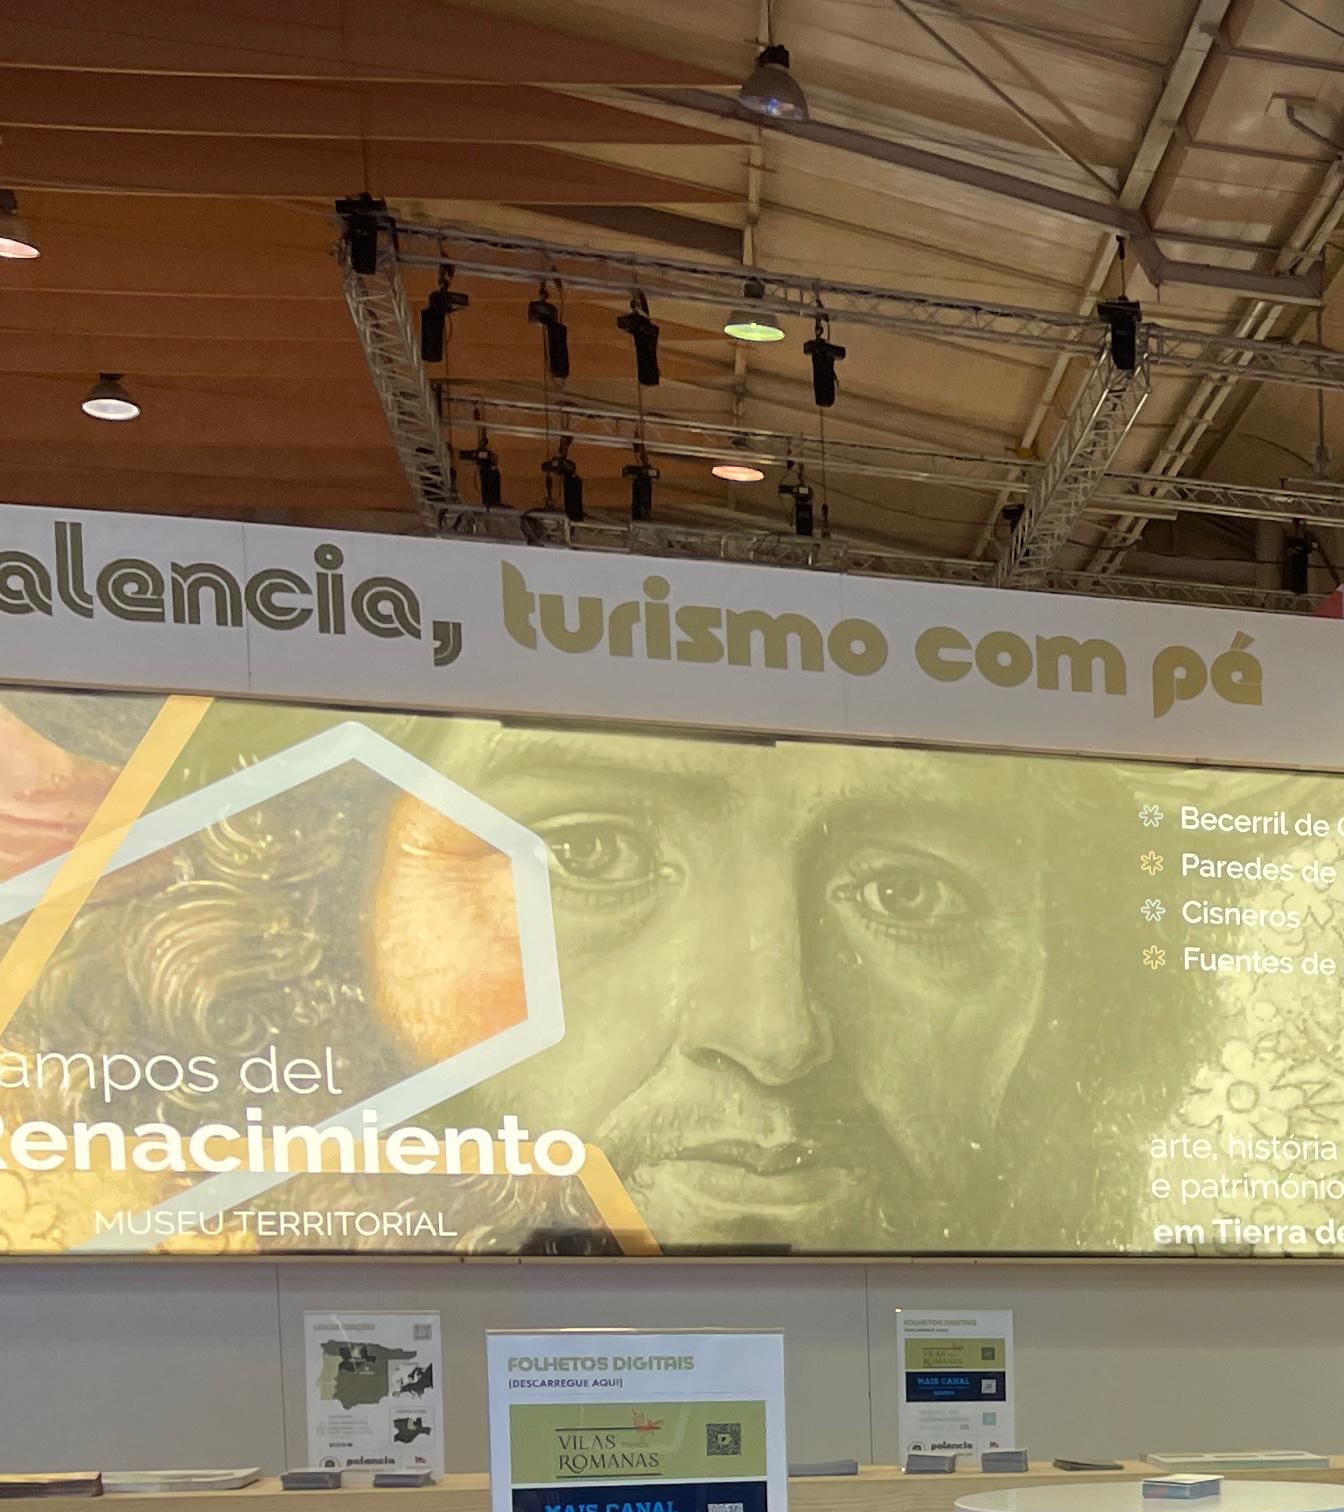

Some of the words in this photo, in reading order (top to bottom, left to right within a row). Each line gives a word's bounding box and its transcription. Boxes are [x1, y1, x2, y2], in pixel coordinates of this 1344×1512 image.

[501, 560, 888, 676] turismo
[915, 626, 1126, 695] com
[1181, 806, 1288, 835] Becerril
[1294, 813, 1329, 837] de
[1181, 853, 1294, 882] Paredes
[1301, 860, 1336, 883] de
[1182, 900, 1301, 928] Cisneros
[1183, 947, 1293, 974] Fuentes
[1301, 952, 1336, 975] de
[240, 1045, 343, 1095] del
[1150, 1136, 1218, 1161] arte,
[1228, 1133, 1337, 1161] história
[1152, 1179, 1170, 1198] e
[95, 1210, 224, 1236] MUSEU
[234, 1210, 458, 1237] TERRITORIAL
[1153, 1224, 1205, 1245] em
[1211, 1218, 1307, 1245] Tierra
[508, 1356, 608, 1373] FOLHETOS
[613, 1355, 695, 1372] DIGITAIS
[508, 1379, 589, 1388] (DESCARREGUE
[592, 1378, 623, 1388] AQUI)
[559, 1434, 616, 1450] VILAS
[559, 1453, 660, 1474] ROMANAS
